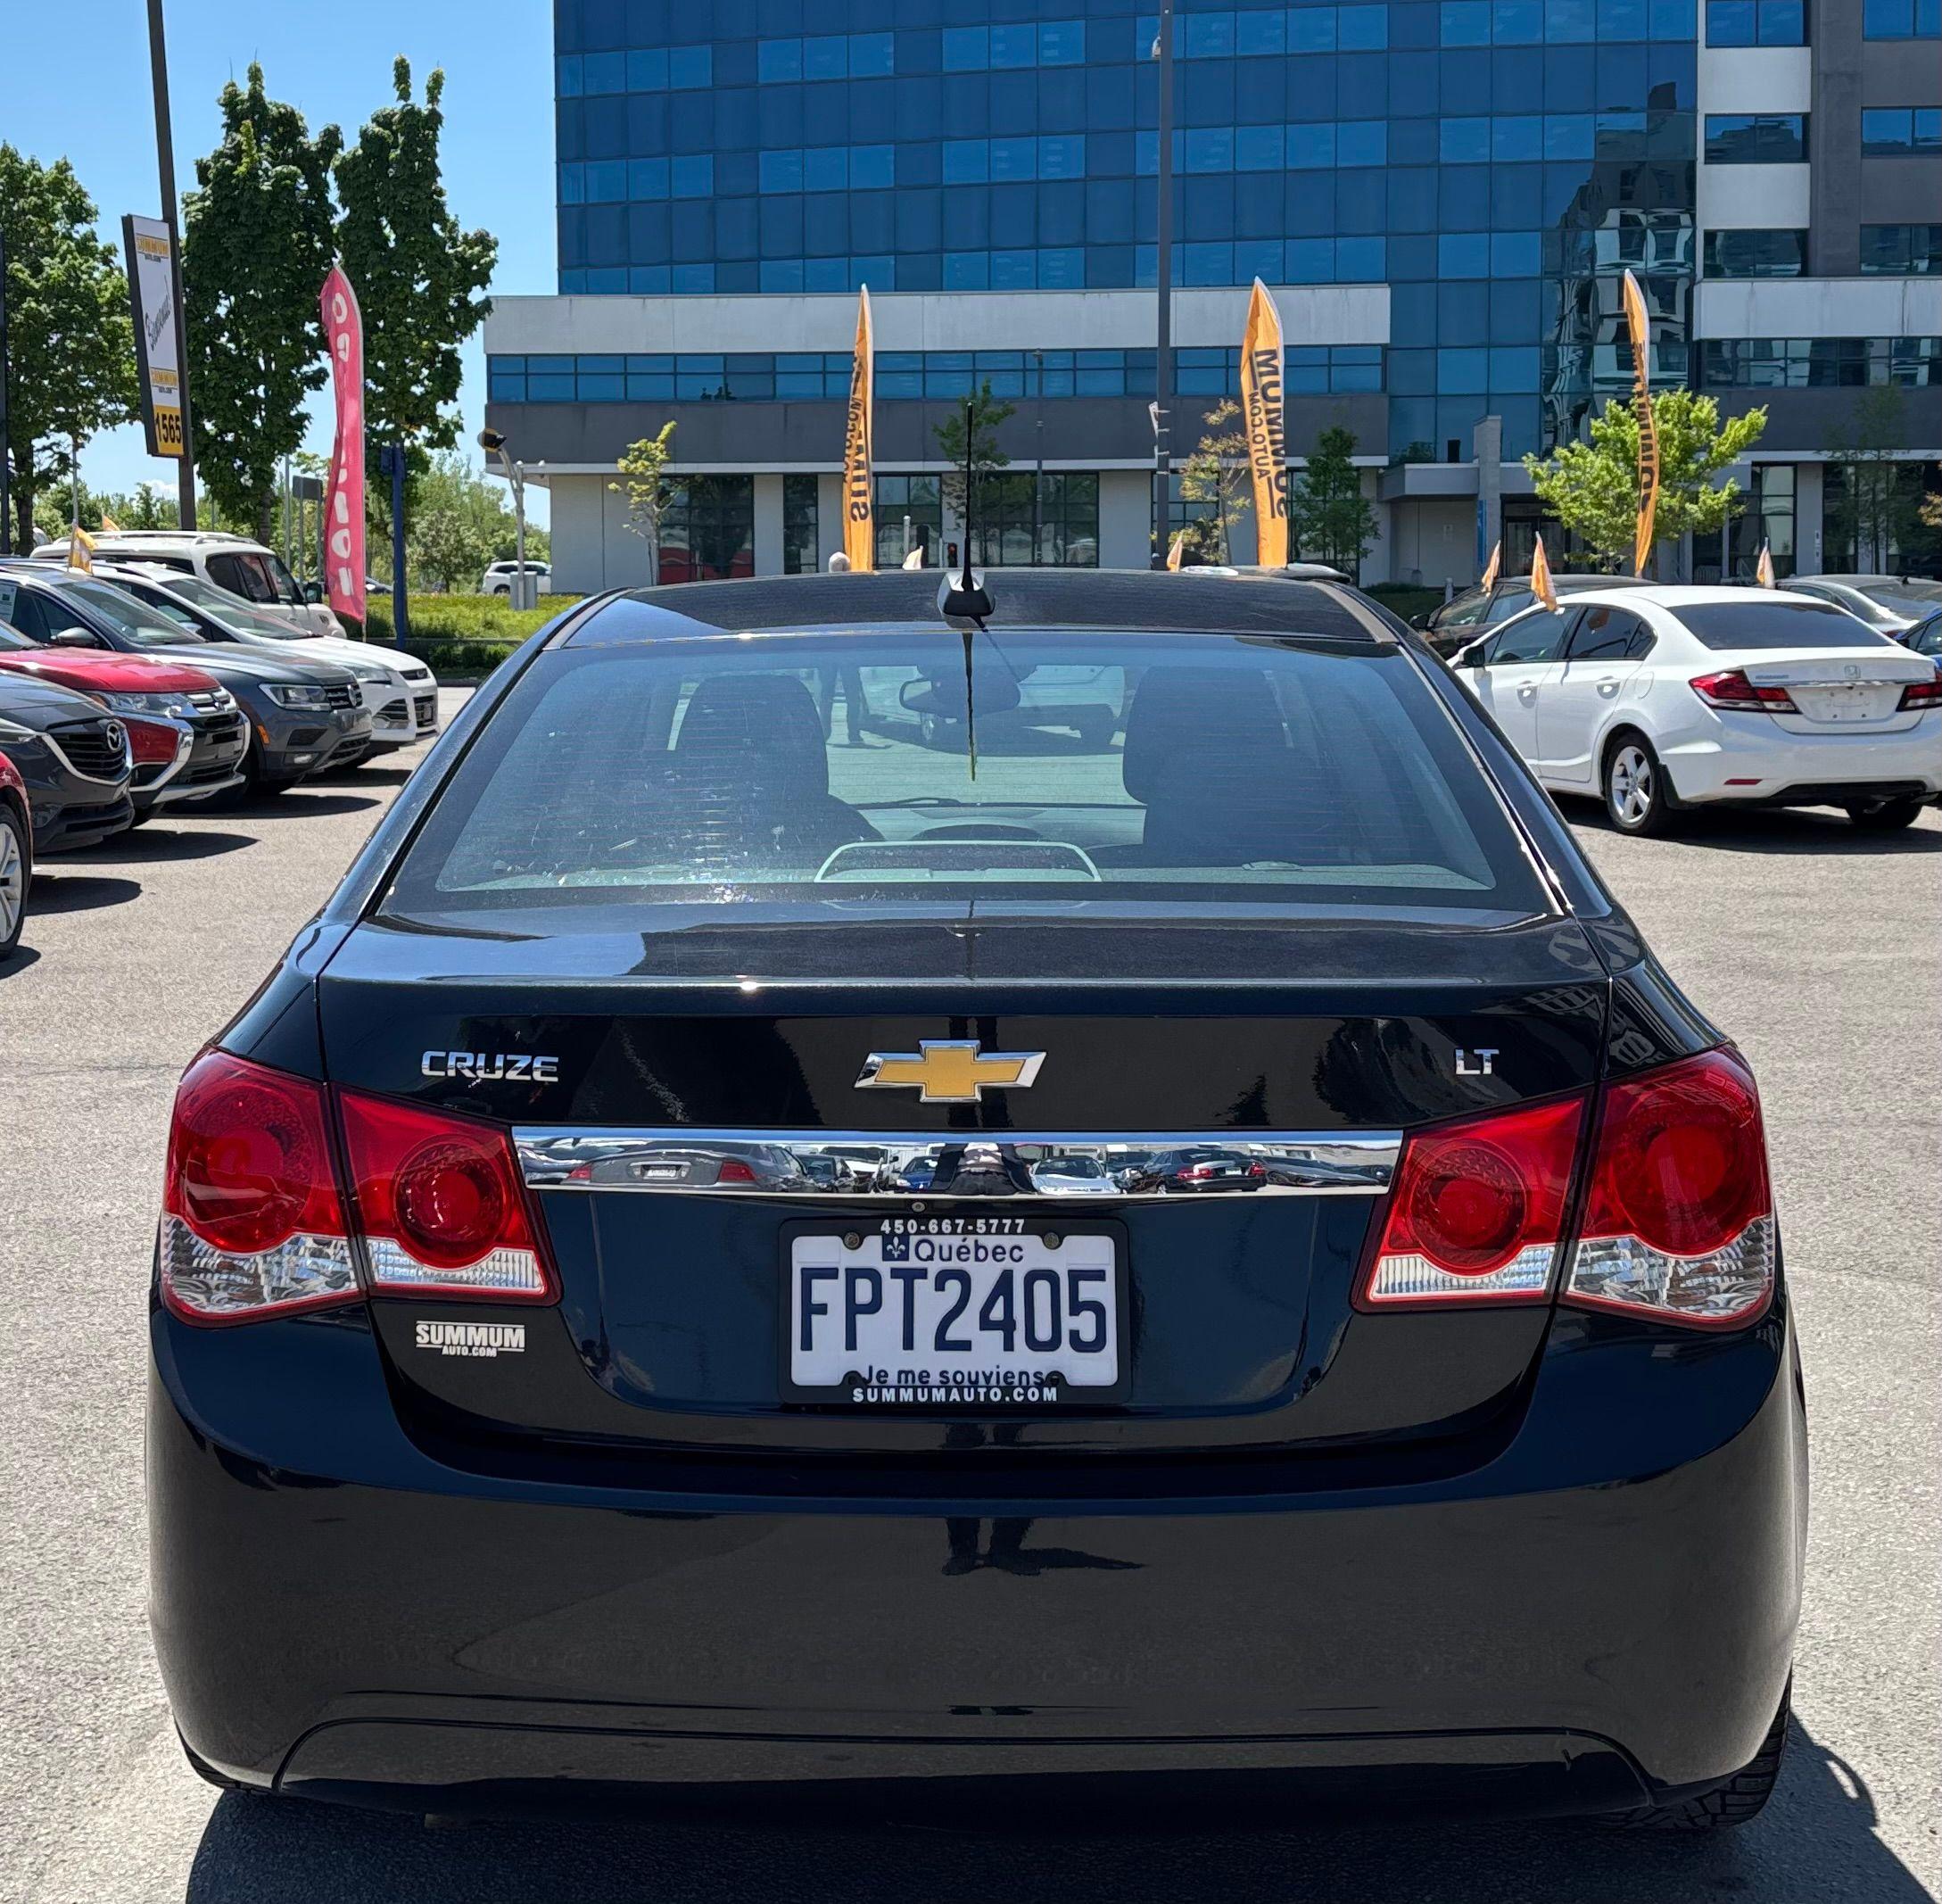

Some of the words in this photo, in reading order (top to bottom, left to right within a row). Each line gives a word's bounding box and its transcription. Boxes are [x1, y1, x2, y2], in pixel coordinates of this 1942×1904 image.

[155, 412, 182, 444] 1565
[421, 1050, 559, 1082] CRUZE
[1455, 1048, 1500, 1075] LT
[880, 1219, 1025, 1234] 450-667-5777
[914, 1237, 1024, 1262] Québec
[800, 1267, 1108, 1353] FPT2405
[416, 1324, 525, 1348] SUMMUM
[442, 1345, 498, 1357] AUTO.COM
[863, 1365, 889, 1386] Je
[897, 1370, 931, 1385] me
[938, 1365, 1045, 1386] souviens
[852, 1387, 1058, 1403] SUMMUMAUTO.COM
